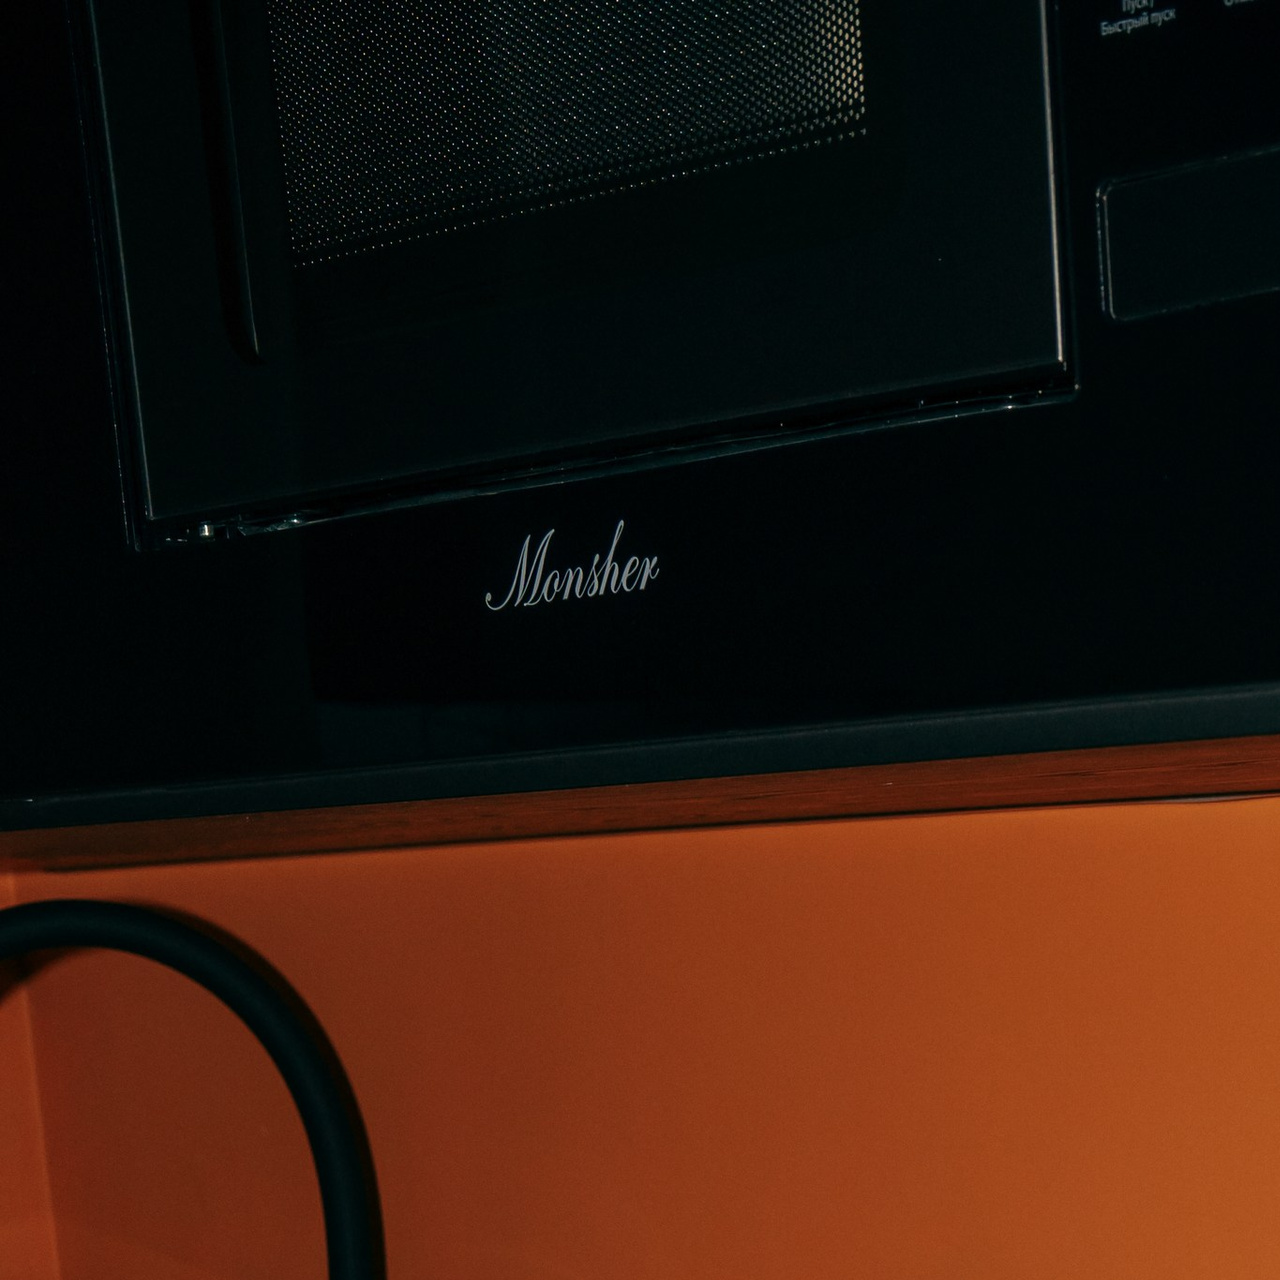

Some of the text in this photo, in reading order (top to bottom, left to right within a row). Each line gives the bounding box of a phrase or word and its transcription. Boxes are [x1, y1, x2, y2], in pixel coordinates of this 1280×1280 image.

[1100, 8, 1176, 36] Быстрый пуск
[485, 519, 660, 611] Monsher
